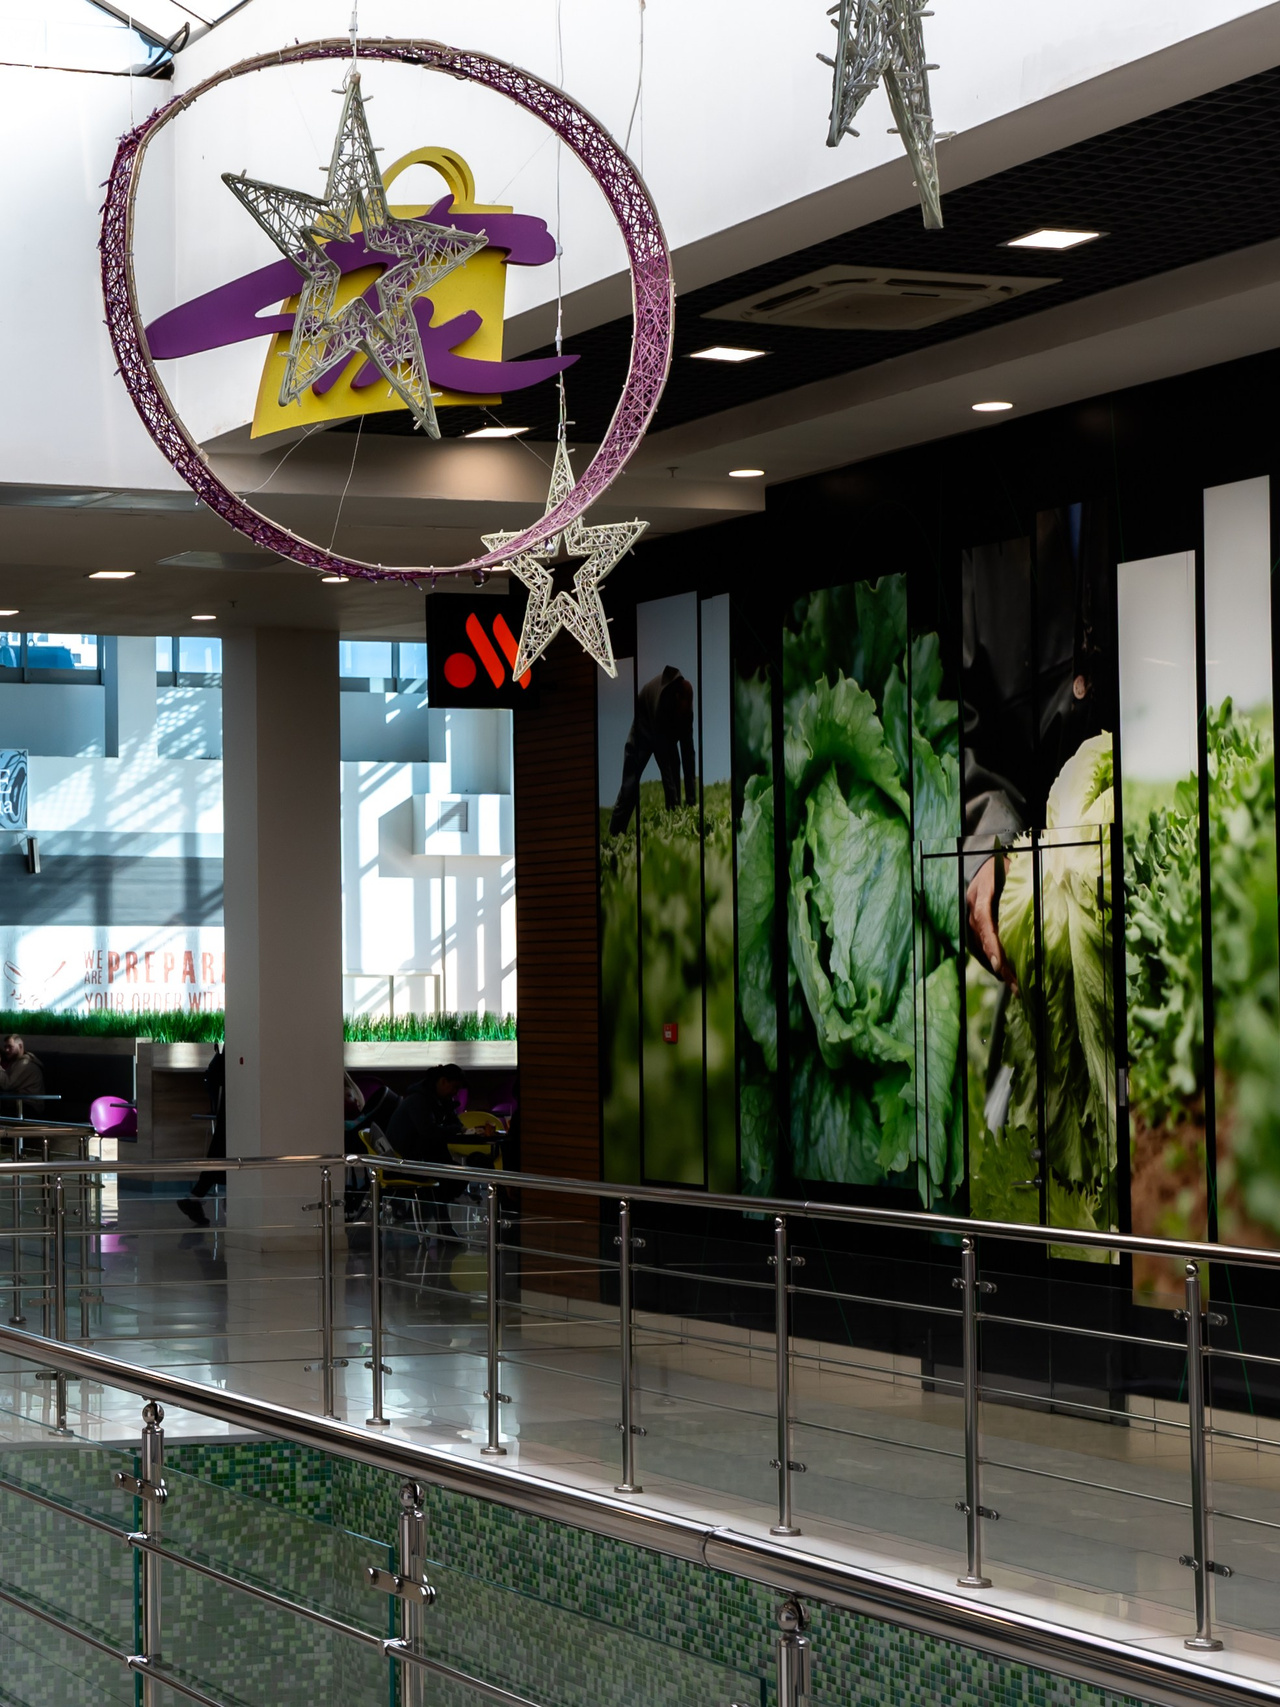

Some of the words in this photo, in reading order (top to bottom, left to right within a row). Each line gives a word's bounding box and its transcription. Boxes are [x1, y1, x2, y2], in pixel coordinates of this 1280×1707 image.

[84, 950, 103, 969] WE
[107, 950, 225, 985] PREPAR
[84, 970, 103, 985] ARE
